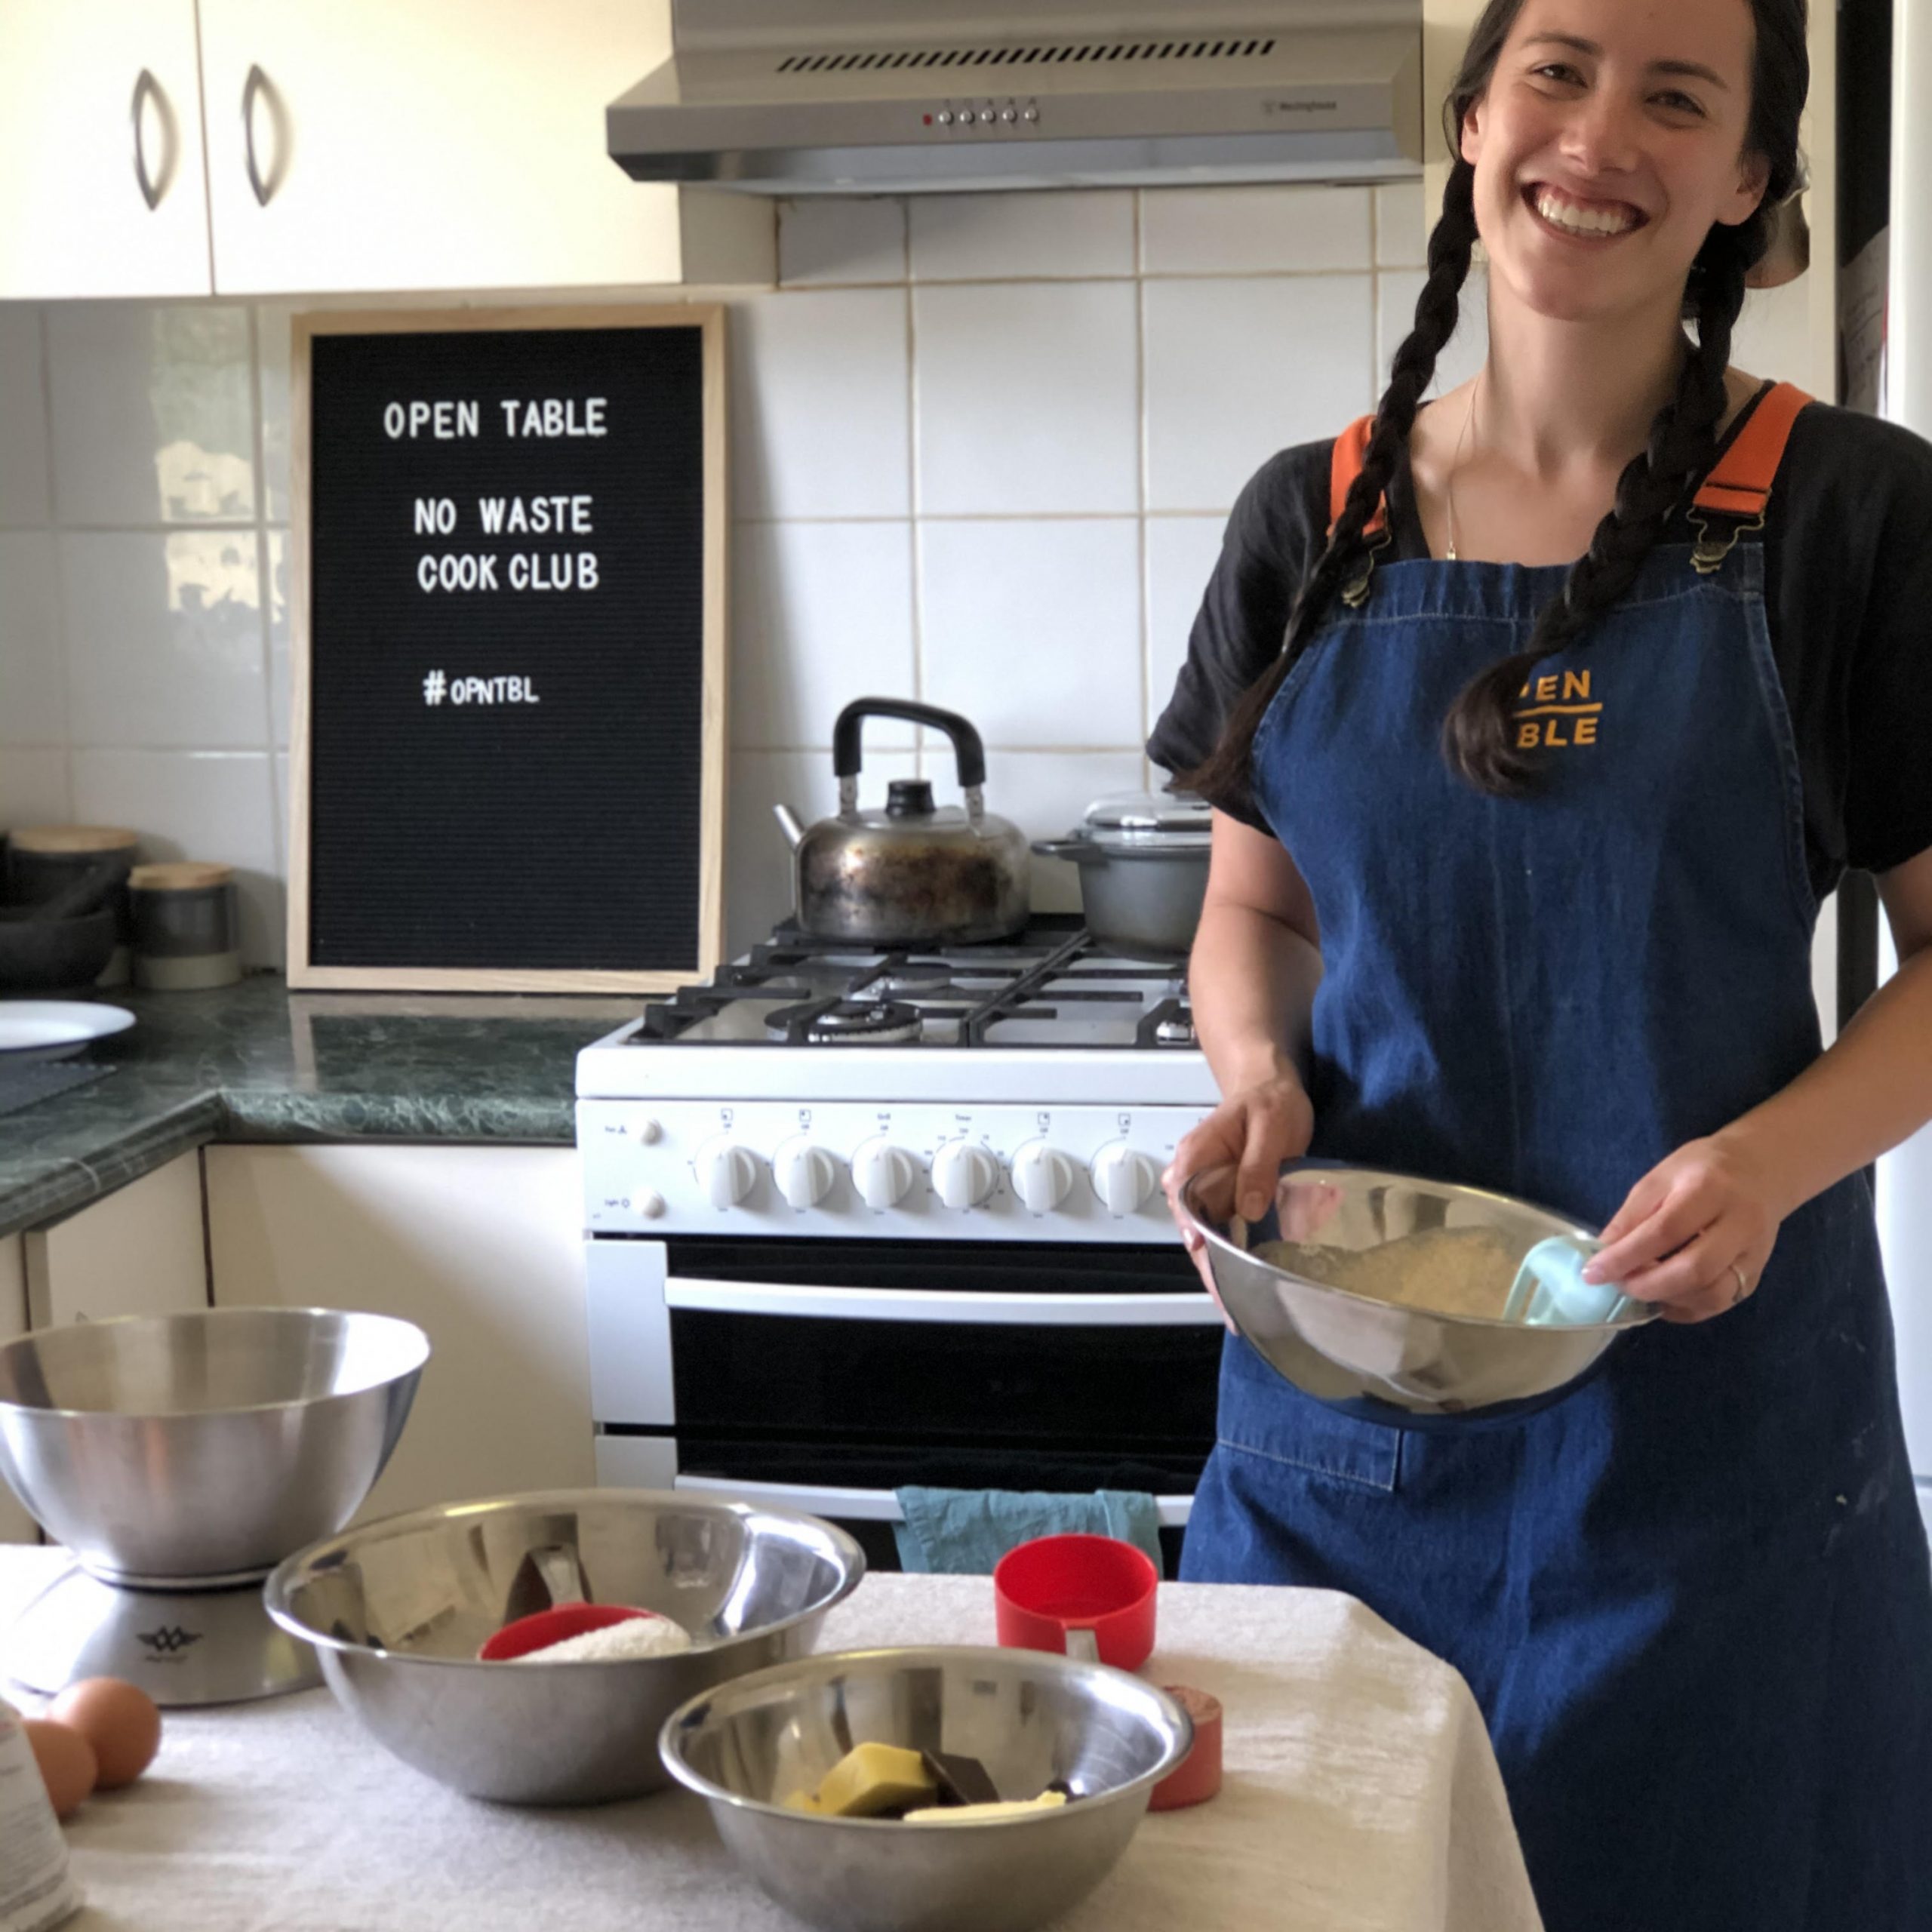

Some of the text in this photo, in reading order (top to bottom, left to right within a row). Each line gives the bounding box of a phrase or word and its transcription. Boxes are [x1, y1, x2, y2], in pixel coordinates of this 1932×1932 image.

[384, 398, 608, 438] OPEN TABLE
[414, 495, 593, 534] NO WASTE
[417, 552, 599, 592] COOK CLUB
[423, 669, 540, 706] #OPNTBL
[1518, 669, 1591, 701] EN
[1516, 717, 1598, 749] BLE
